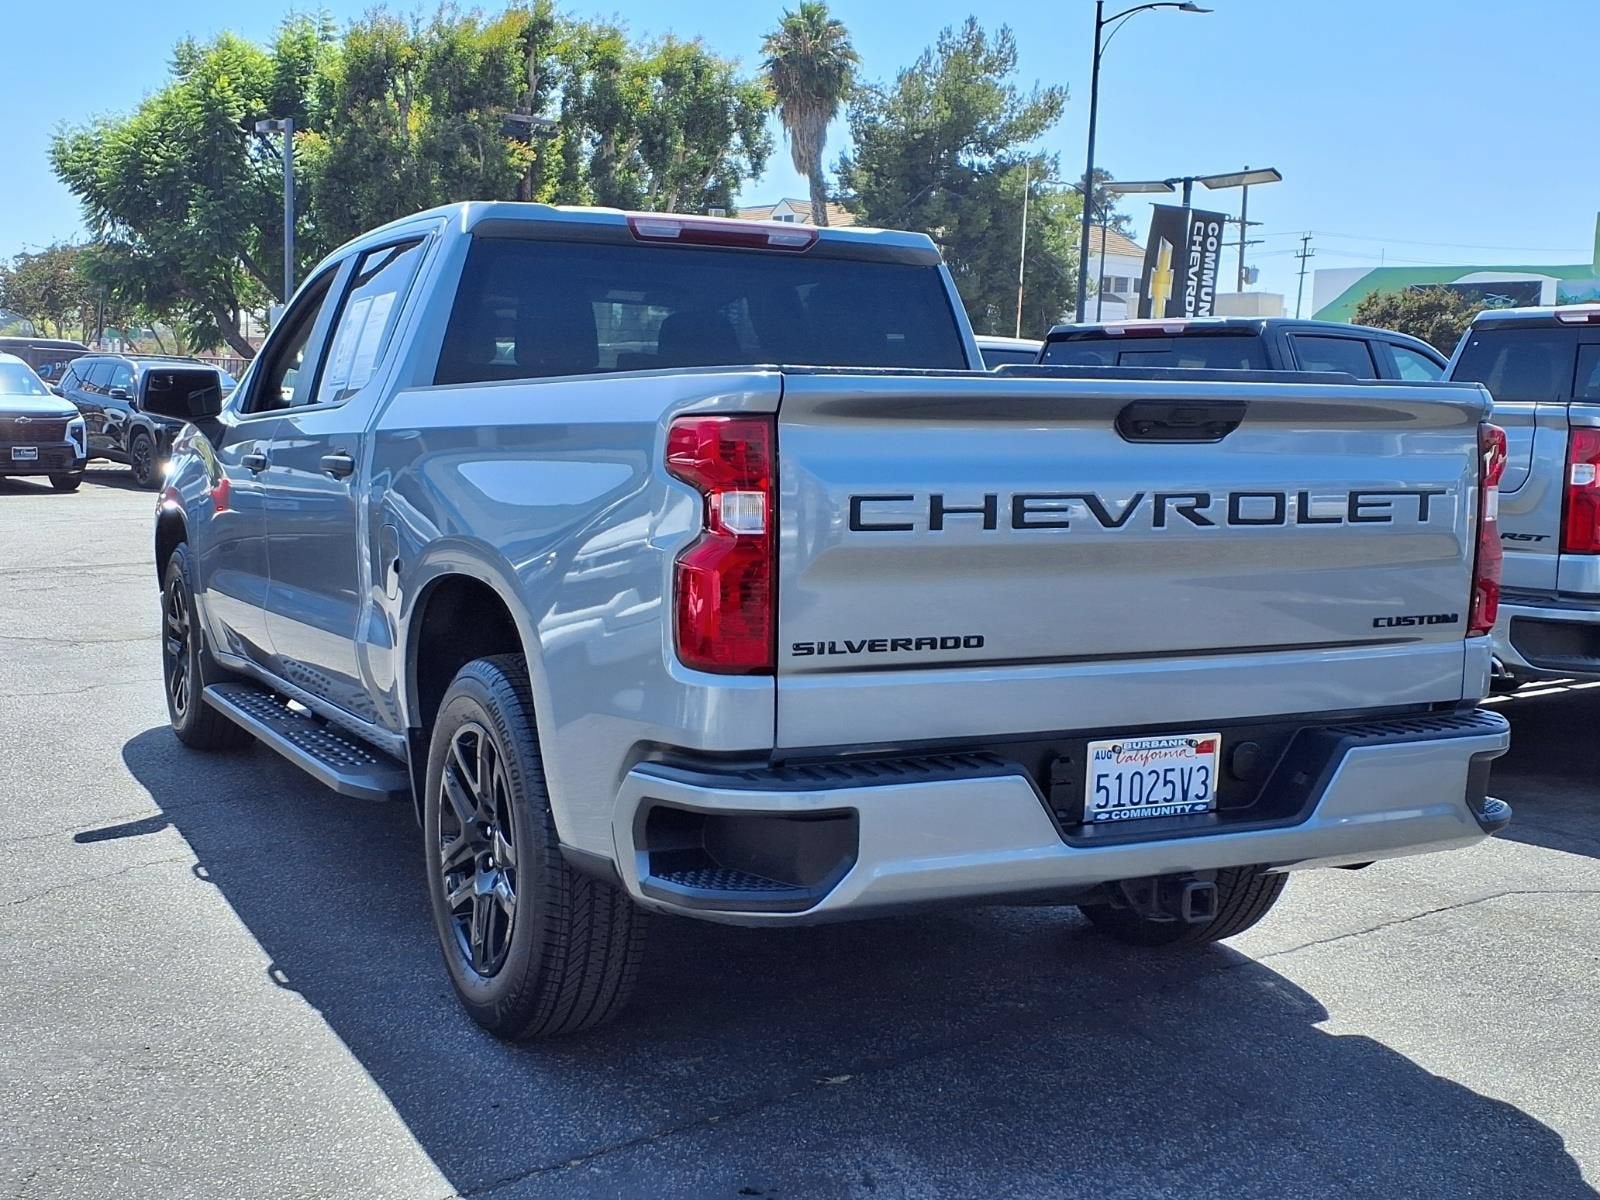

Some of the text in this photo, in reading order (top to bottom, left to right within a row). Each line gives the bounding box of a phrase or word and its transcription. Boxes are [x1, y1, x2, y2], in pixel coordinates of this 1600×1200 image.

[849, 490, 1447, 531] CHEVROLET
[1500, 532, 1551, 542] RST
[1372, 613, 1459, 628] CUSTOM
[792, 635, 985, 656] SILVERADO
[1123, 738, 1188, 750] BURBANK
[1095, 750, 1113, 761] AUG
[1116, 748, 1194, 767] California
[1095, 765, 1209, 809] 51025V3
[1111, 804, 1193, 820] COMMUNITY
